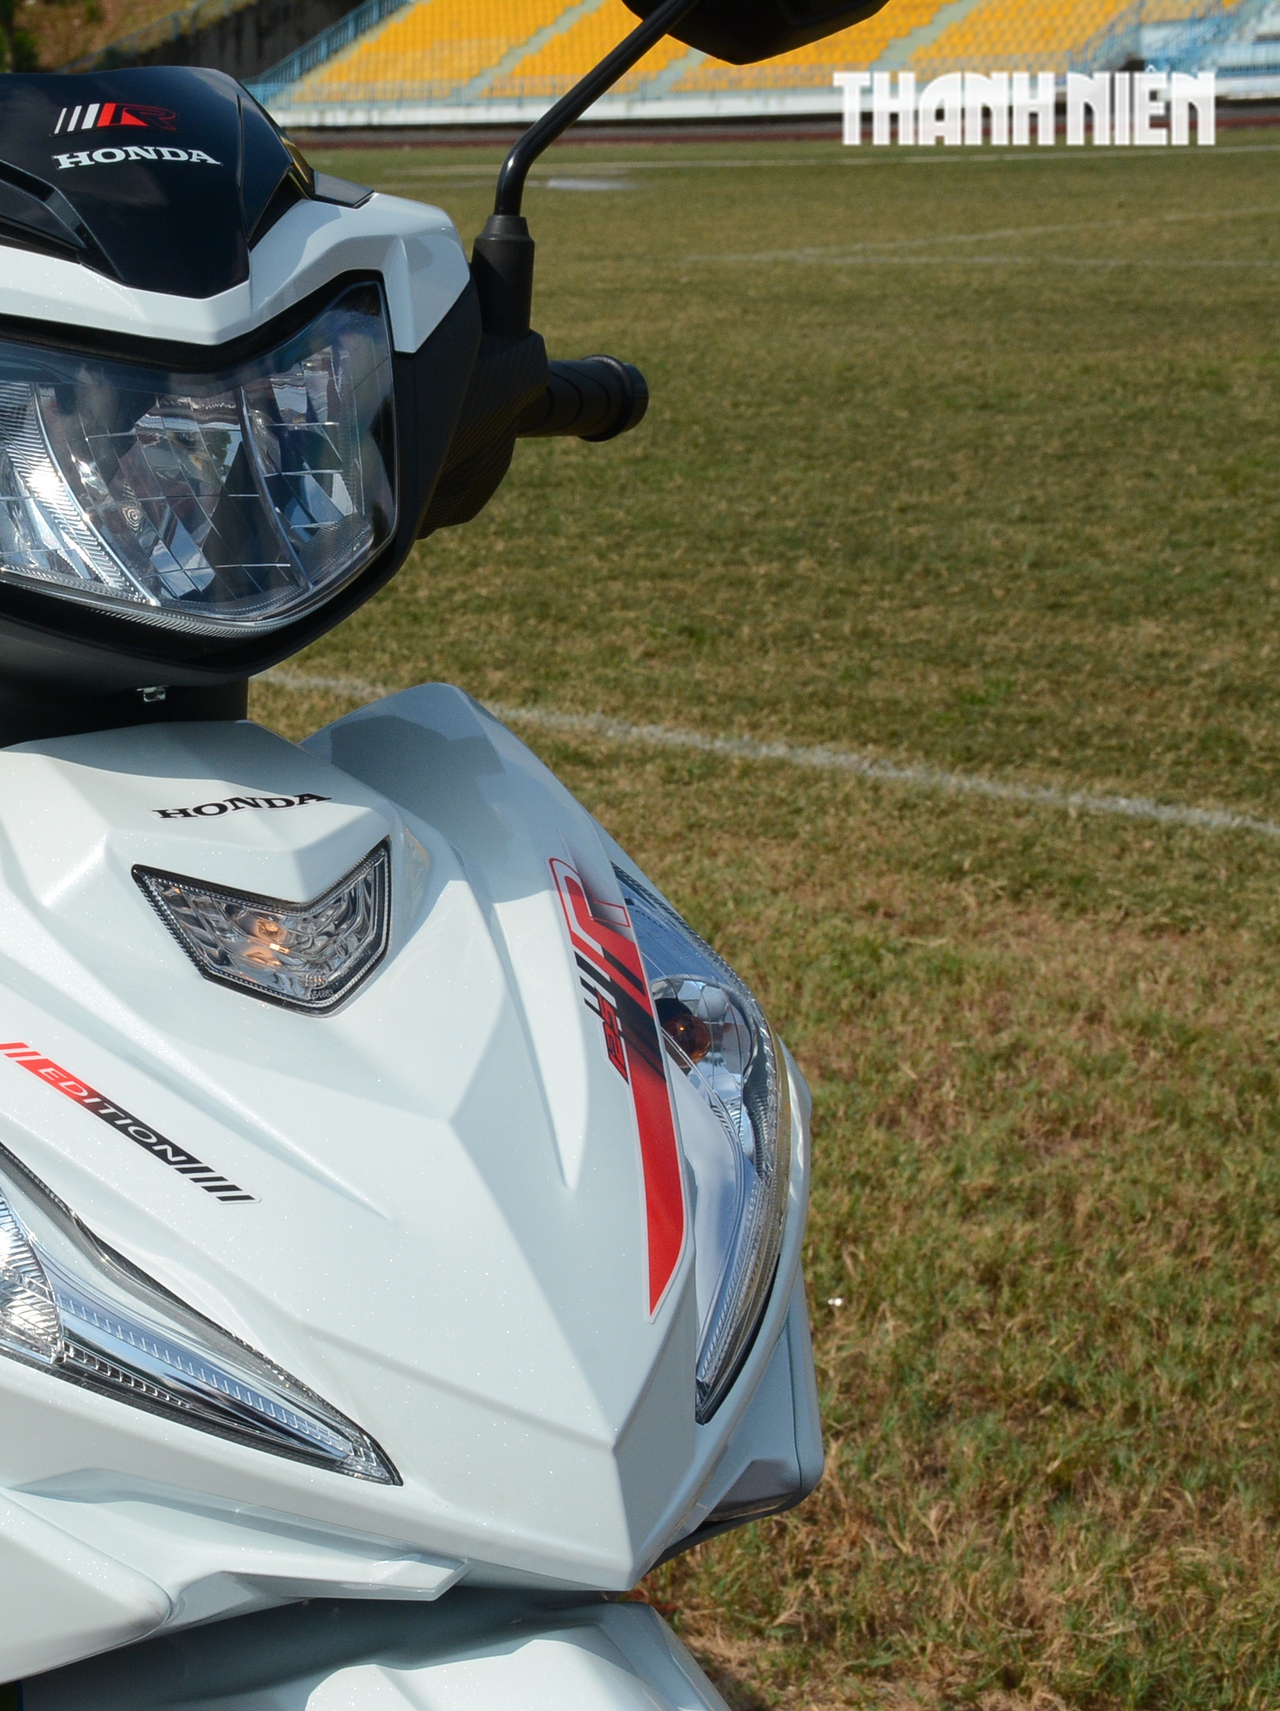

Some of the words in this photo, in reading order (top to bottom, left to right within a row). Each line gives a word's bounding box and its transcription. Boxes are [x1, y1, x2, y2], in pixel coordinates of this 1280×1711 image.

[53, 146, 222, 170] HONDA
[153, 793, 332, 819] HONDA
[36, 1066, 188, 1164] EDITION
